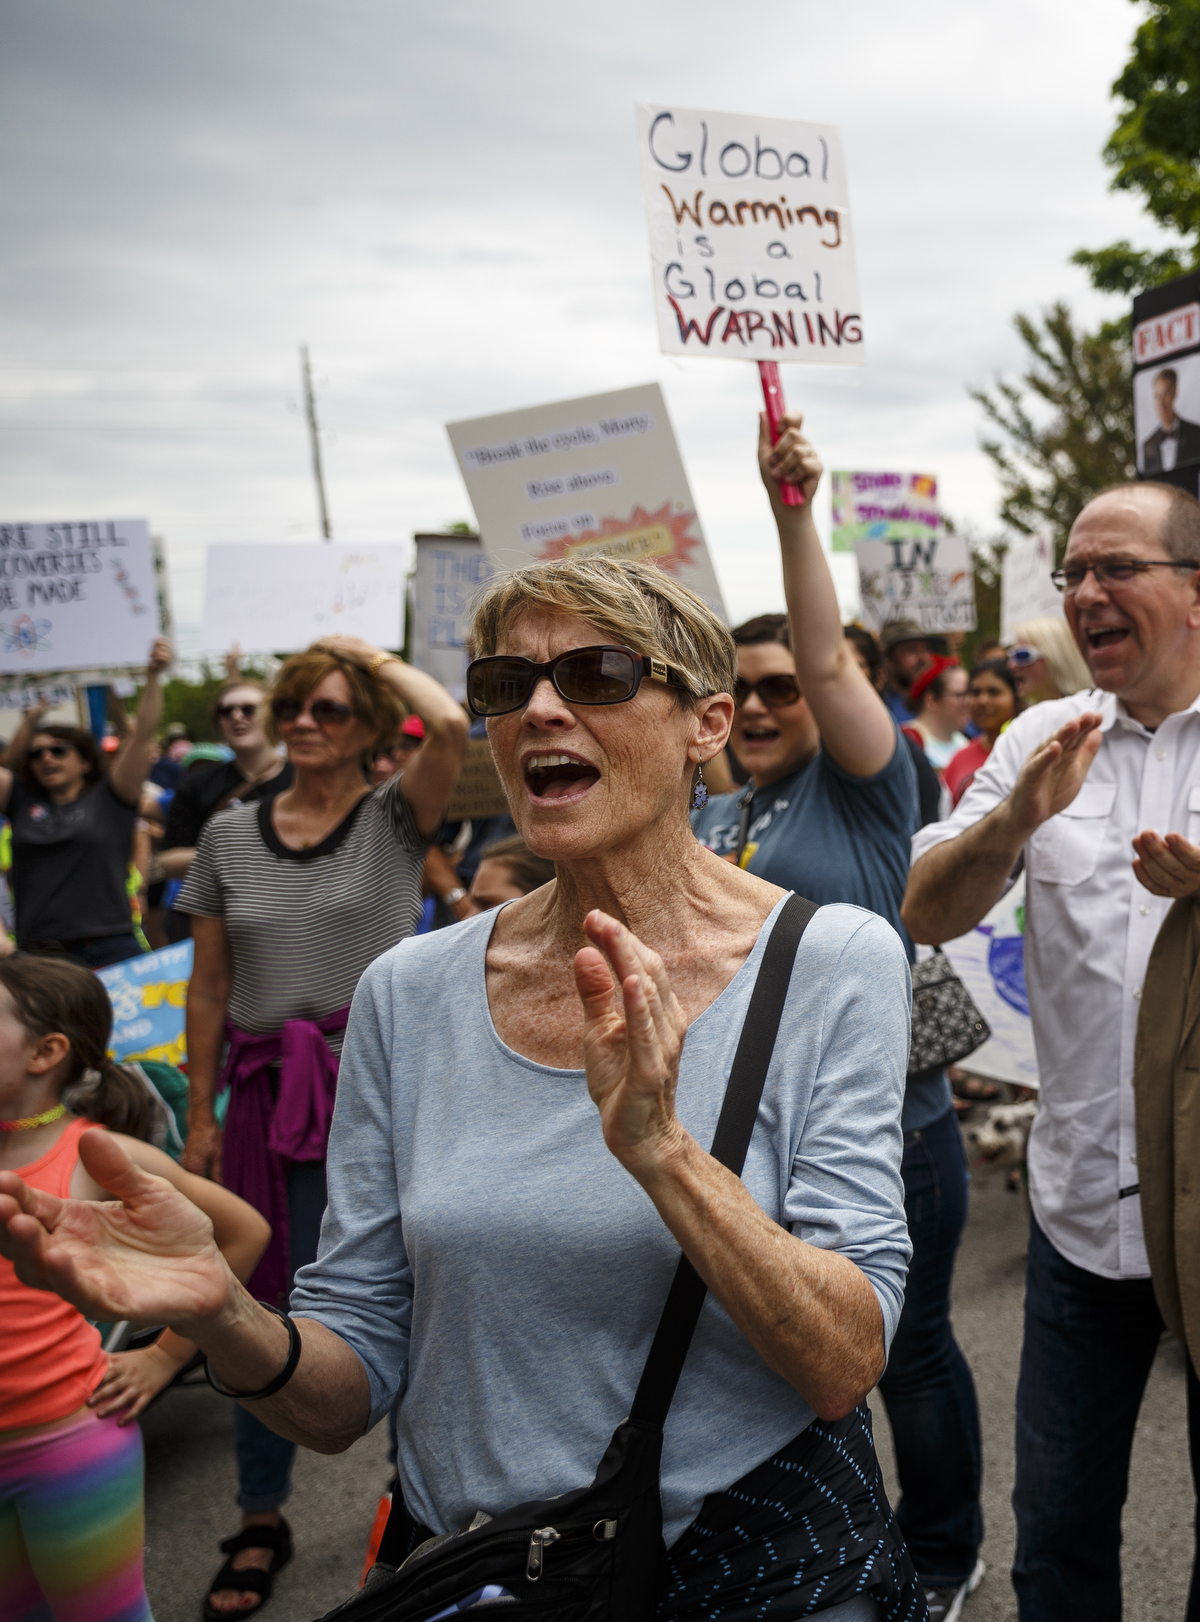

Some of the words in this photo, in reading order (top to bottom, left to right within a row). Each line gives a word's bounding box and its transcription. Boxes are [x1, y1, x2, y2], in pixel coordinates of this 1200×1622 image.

[649, 112, 828, 183] Global
[661, 184, 842, 248] Warming
[675, 228, 714, 258] is
[766, 240, 793, 260] a
[664, 261, 823, 302] Global
[667, 294, 863, 347] WARNING
[1136, 311, 1196, 357] FACT
[45, 520, 129, 549] STILL
[27, 574, 87, 608] MADE
